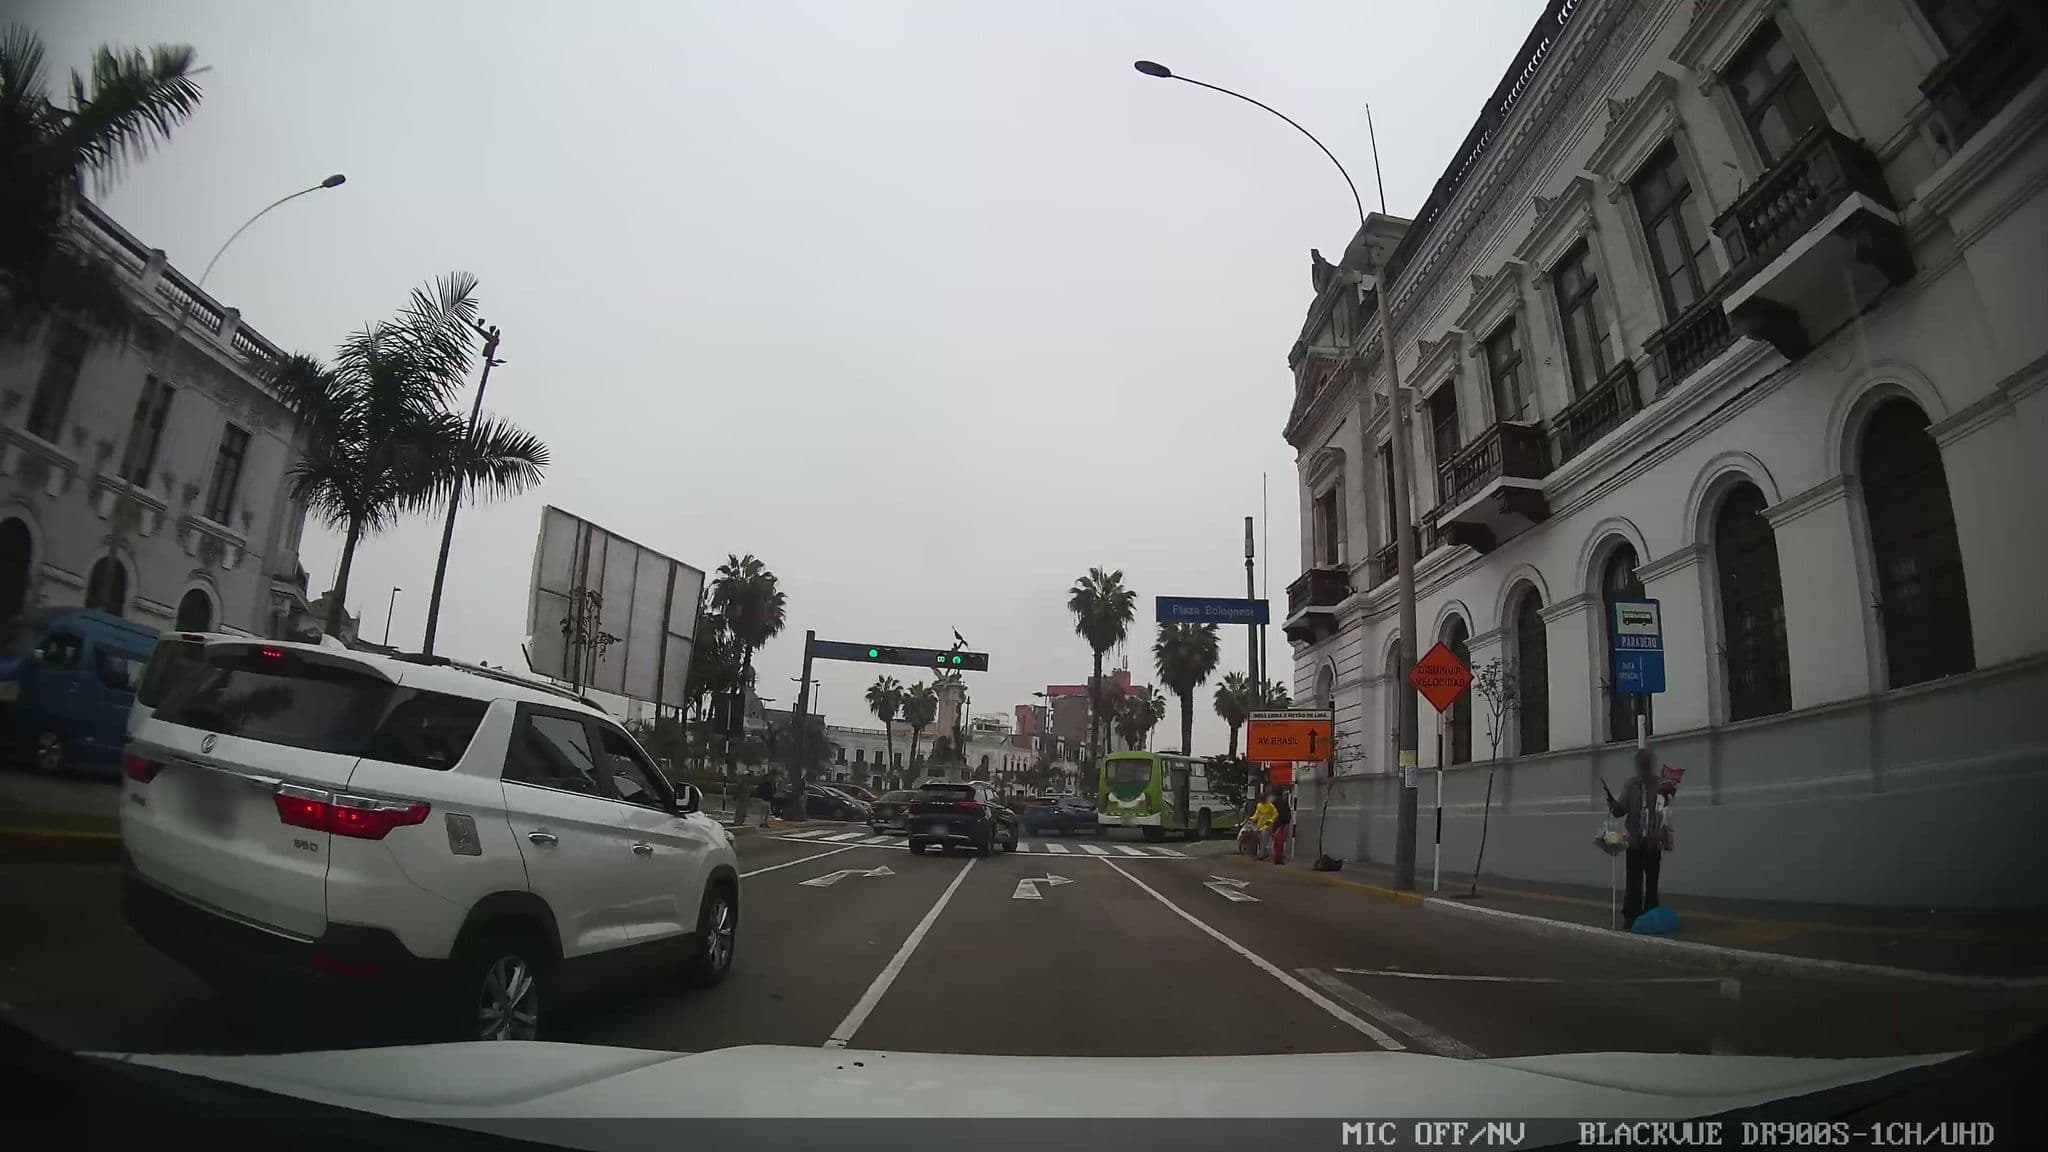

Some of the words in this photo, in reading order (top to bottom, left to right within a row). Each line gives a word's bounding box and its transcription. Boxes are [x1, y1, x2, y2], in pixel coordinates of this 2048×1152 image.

[1172, 604, 1200, 616] Plaza
[1621, 635, 1657, 648] PARADERO
[1416, 677, 1465, 687] VELOCIDAD
[1271, 736, 1298, 745] BRASIL
